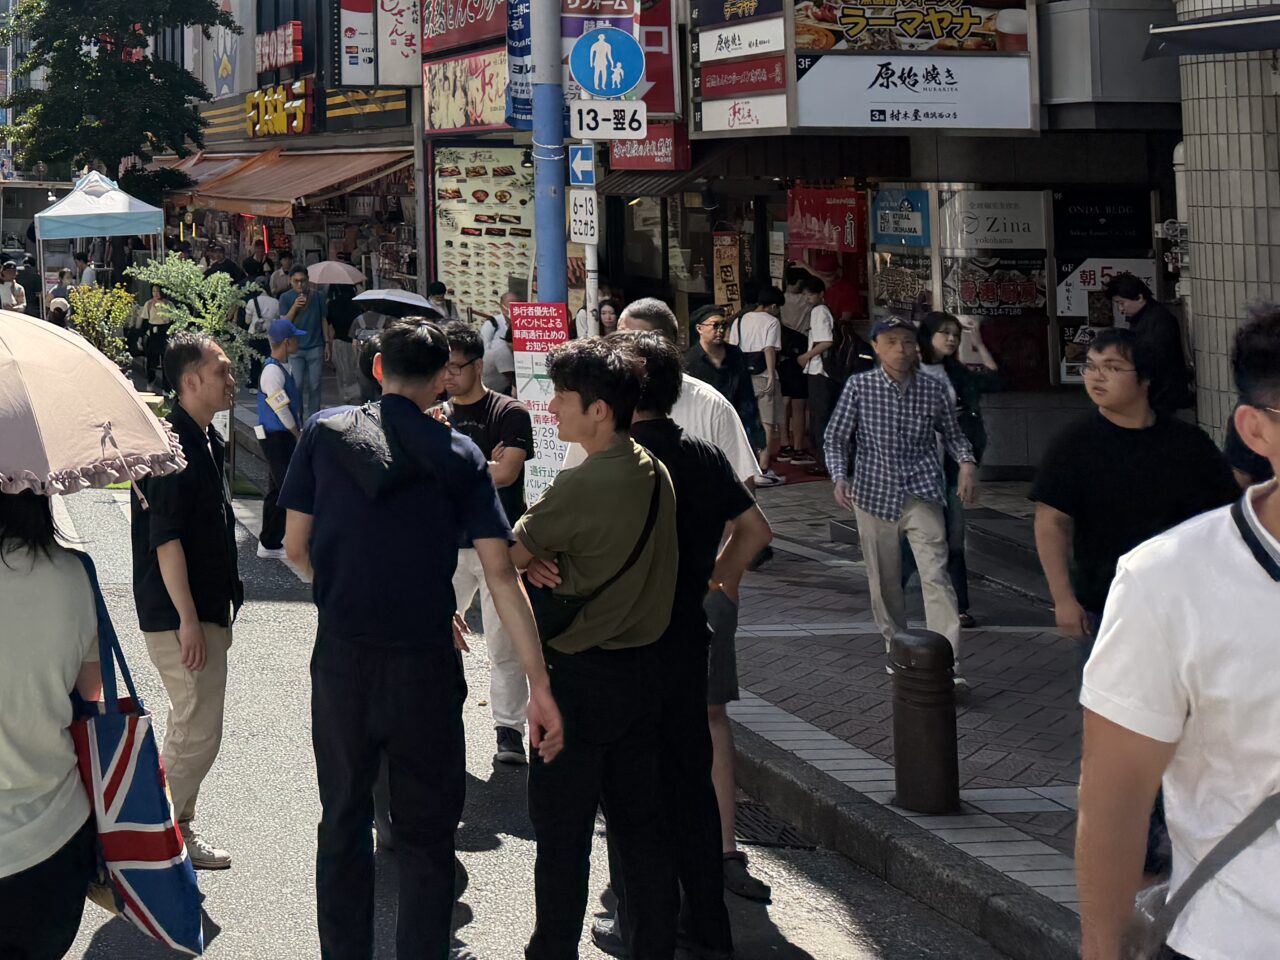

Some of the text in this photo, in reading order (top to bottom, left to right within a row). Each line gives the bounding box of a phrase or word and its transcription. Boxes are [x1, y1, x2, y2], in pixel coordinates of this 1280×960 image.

[692, 8, 699, 19] 4F
[839, 6, 982, 40] ラーマヤナ
[692, 43, 699, 54] 3F
[798, 58, 811, 68] 3F
[694, 77, 700, 88] 2F
[867, 61, 959, 93] 原始焼き
[577, 109, 642, 131] 13-翌6
[695, 112, 701, 122] 1F
[889, 109, 922, 122] 村木屋
[573, 197, 594, 216] 6-13
[572, 219, 596, 238] ここから
[986, 216, 1032, 233] Zina
[974, 237, 1014, 246] yokohama
[1062, 263, 1074, 272] 6F
[514, 318, 563, 328] イベントによる
[513, 329, 566, 340] 車両通行止めの
